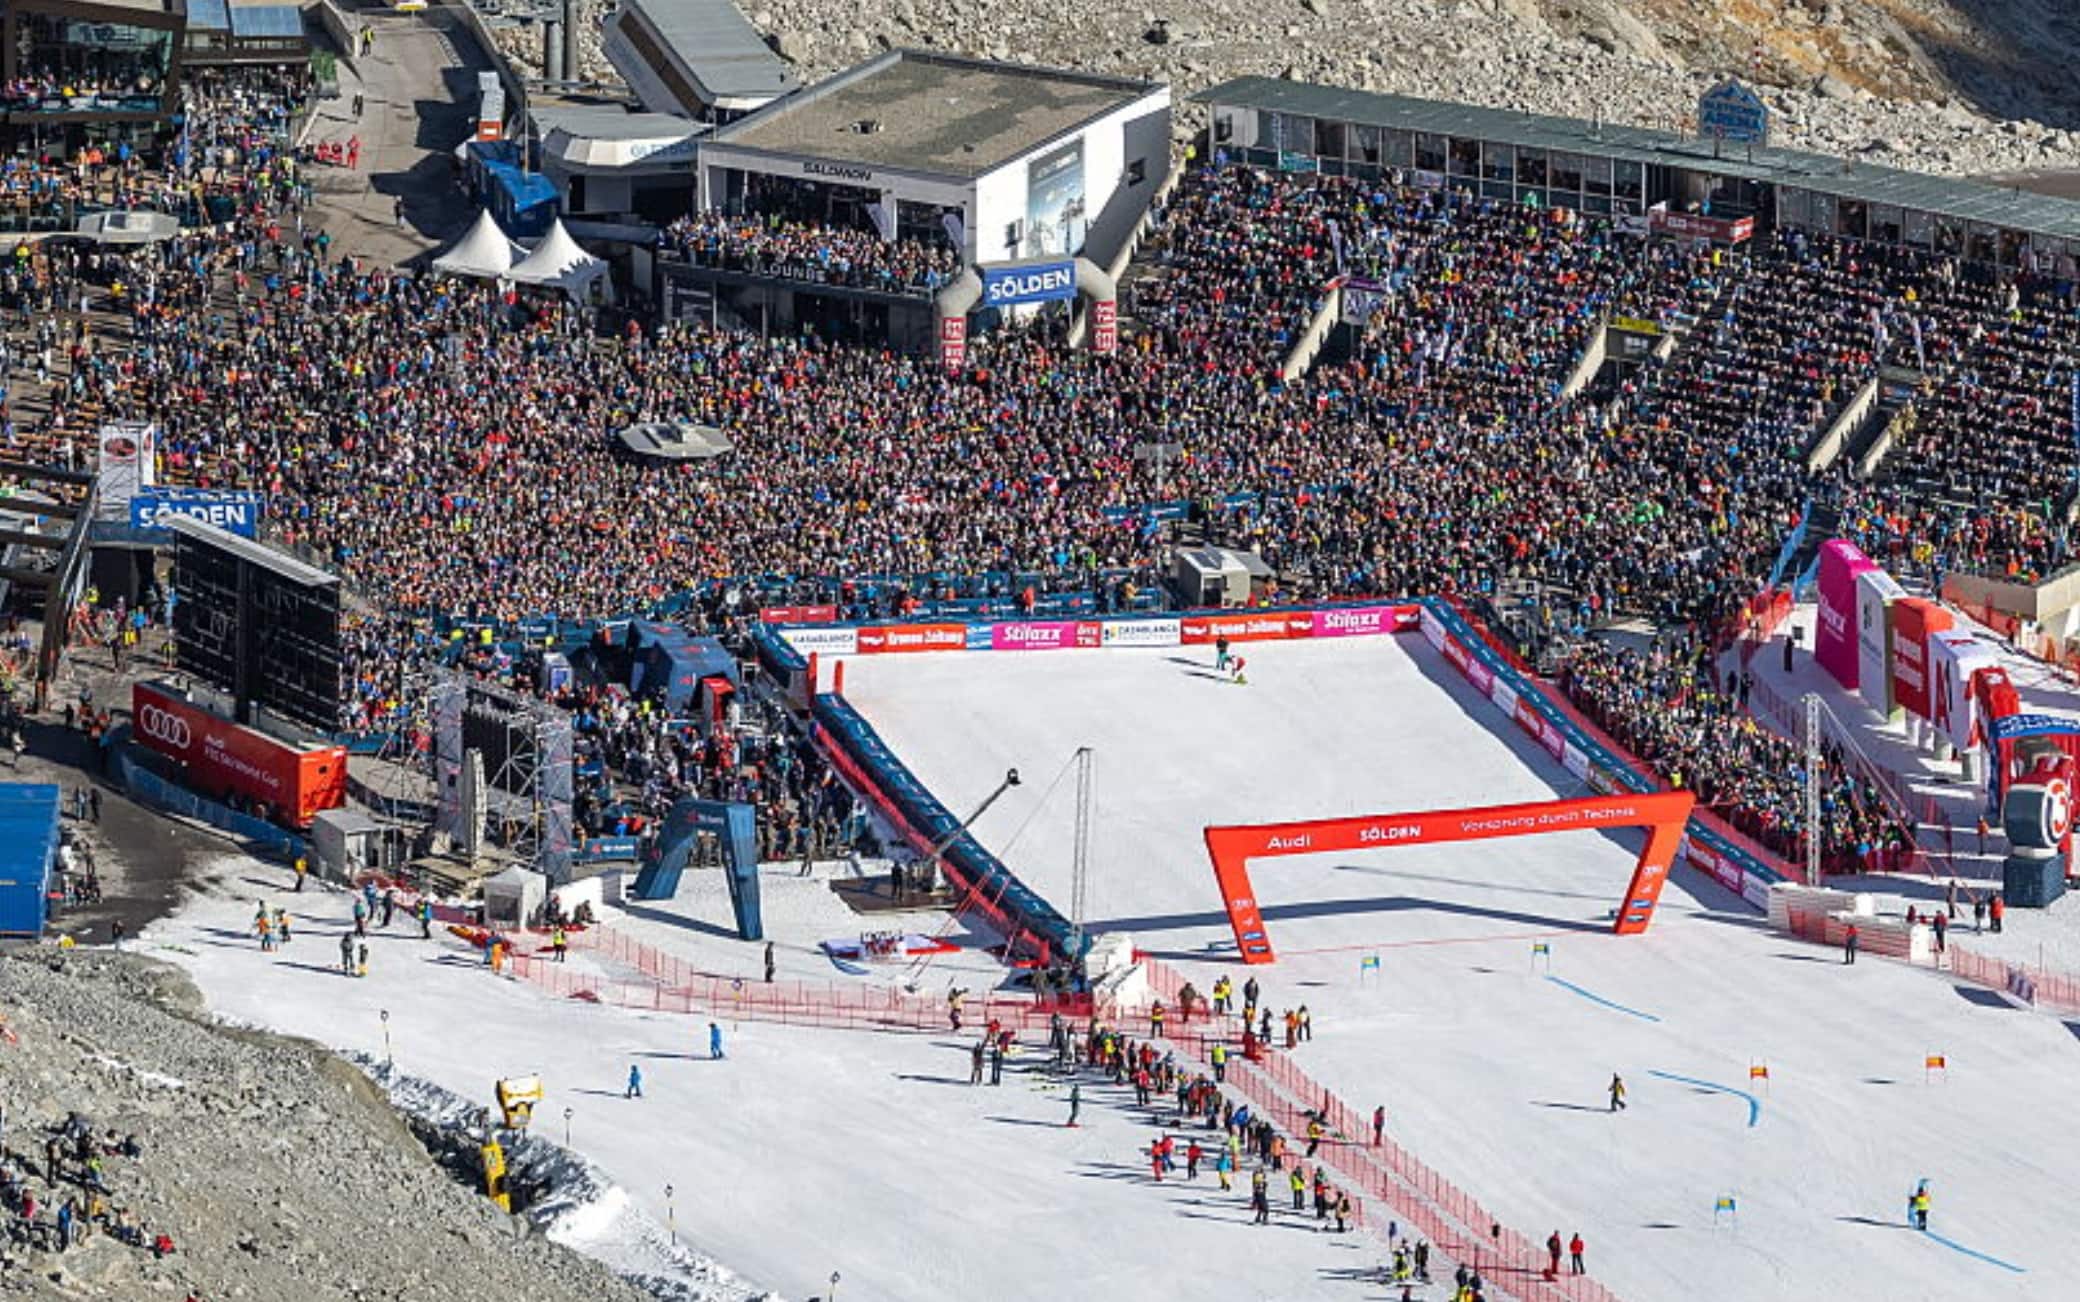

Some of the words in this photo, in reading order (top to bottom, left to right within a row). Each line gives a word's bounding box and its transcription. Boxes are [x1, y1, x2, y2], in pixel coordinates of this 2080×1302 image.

[803, 162, 872, 181] SALOMON
[989, 267, 1070, 300] SÖLDEN
[1267, 835, 1312, 849] Audi
[1360, 825, 1422, 842] SÖLDEN
[1461, 815, 1536, 832] Vorsprung
[1538, 809, 1580, 824] durch
[1583, 806, 1636, 820] Technik
